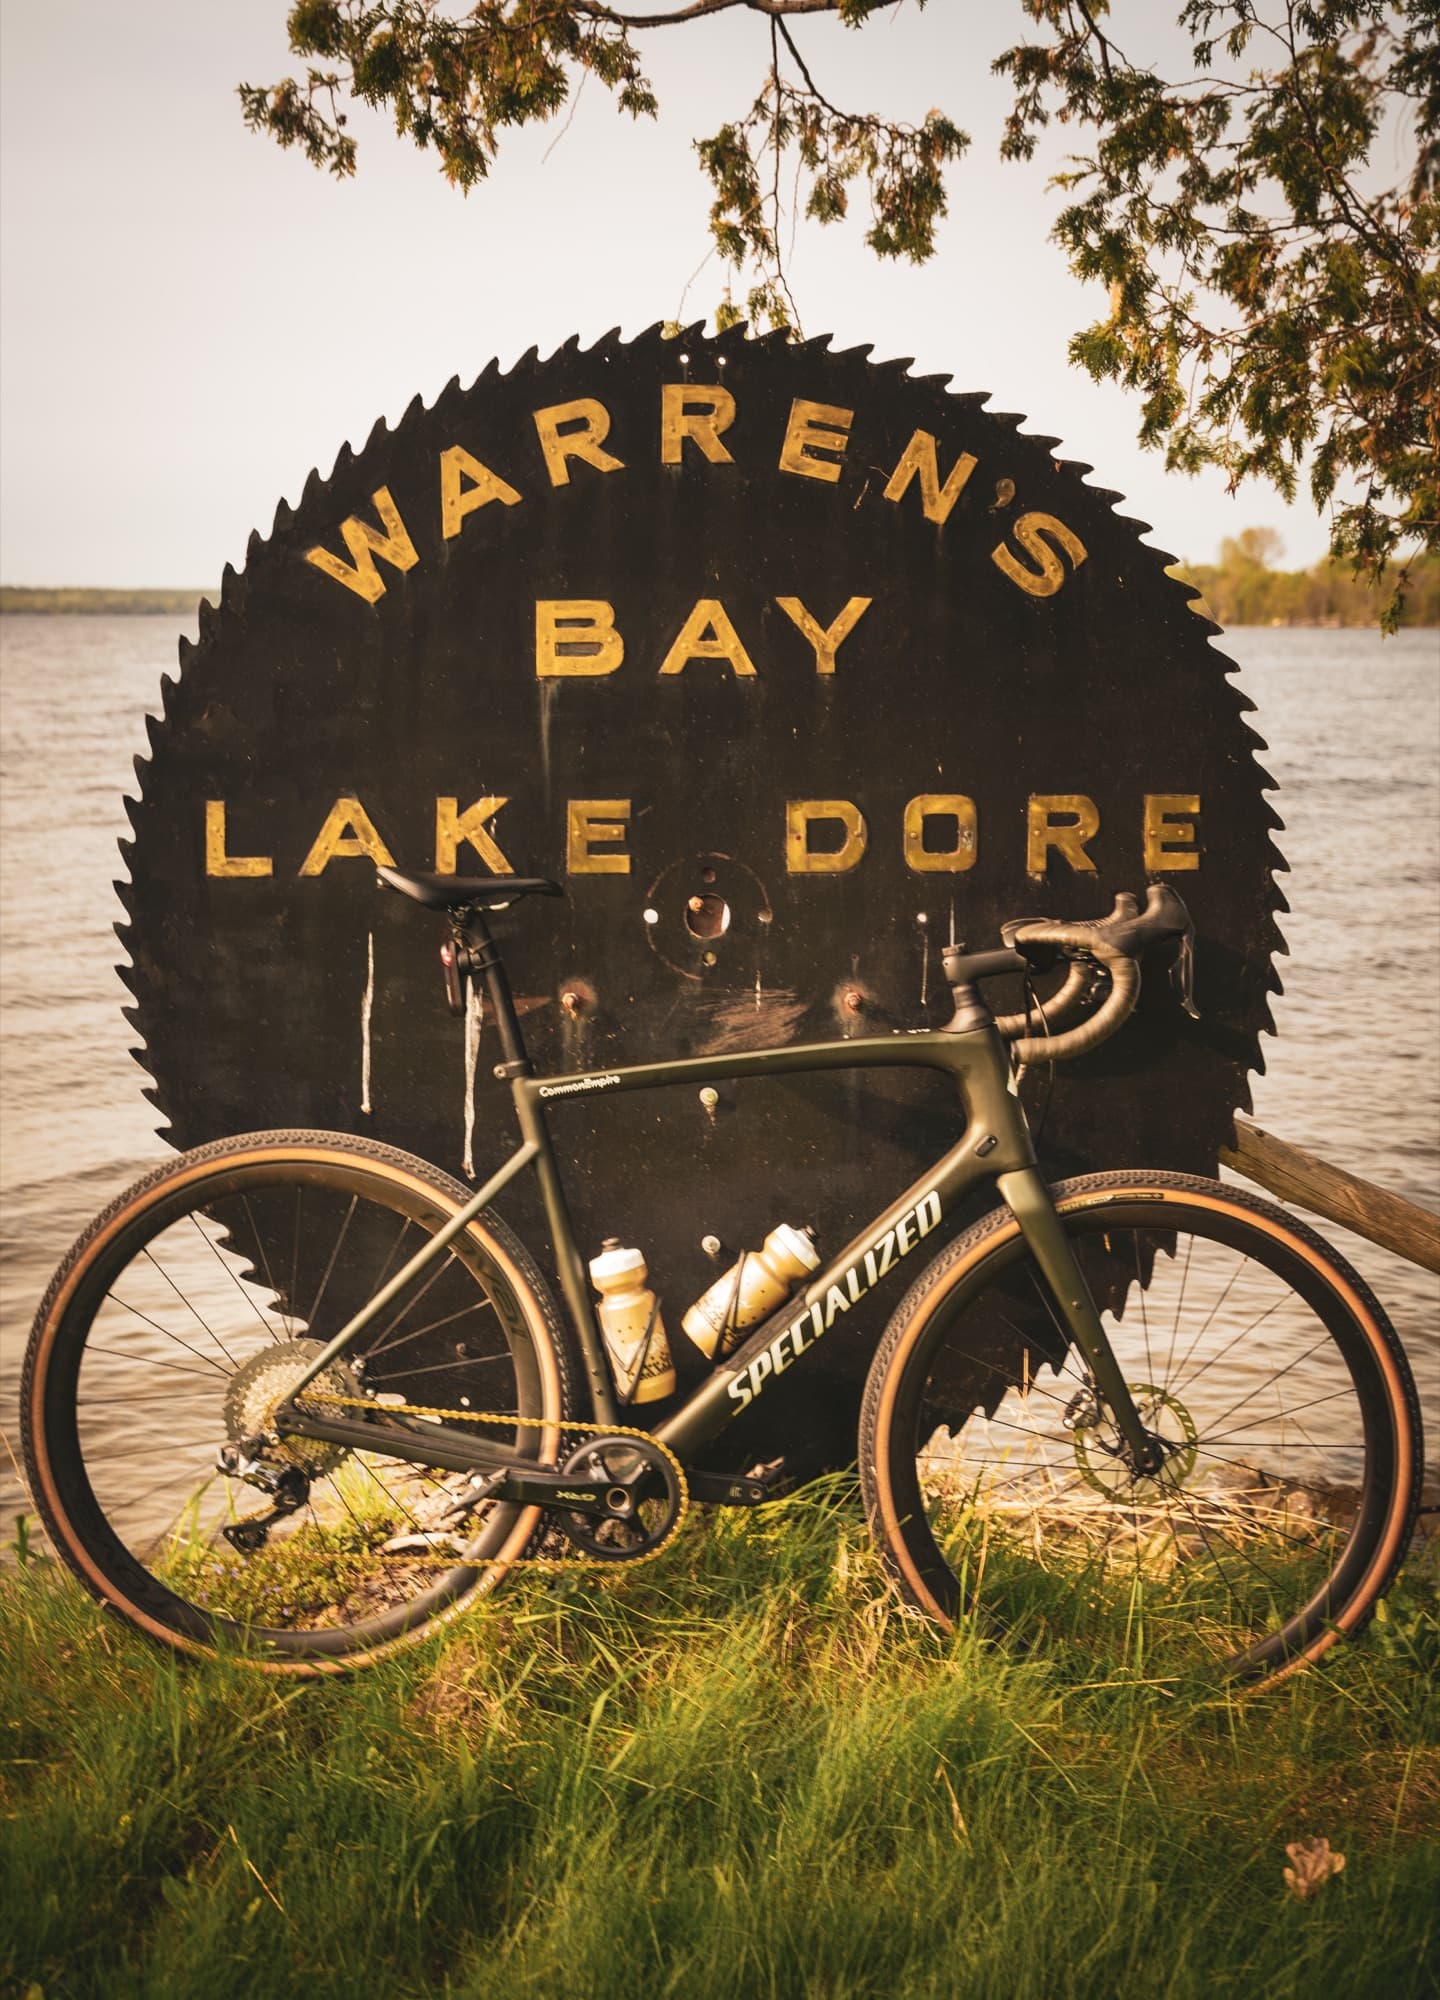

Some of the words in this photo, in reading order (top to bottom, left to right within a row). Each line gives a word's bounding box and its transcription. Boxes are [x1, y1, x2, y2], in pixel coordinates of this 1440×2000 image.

[304, 383, 1089, 607] WARREN'S
[534, 596, 873, 679] BAY
[205, 796, 632, 877] LAKE
[783, 793, 1202, 877] DORE
[726, 1189, 944, 1416] SPECIALIZED
